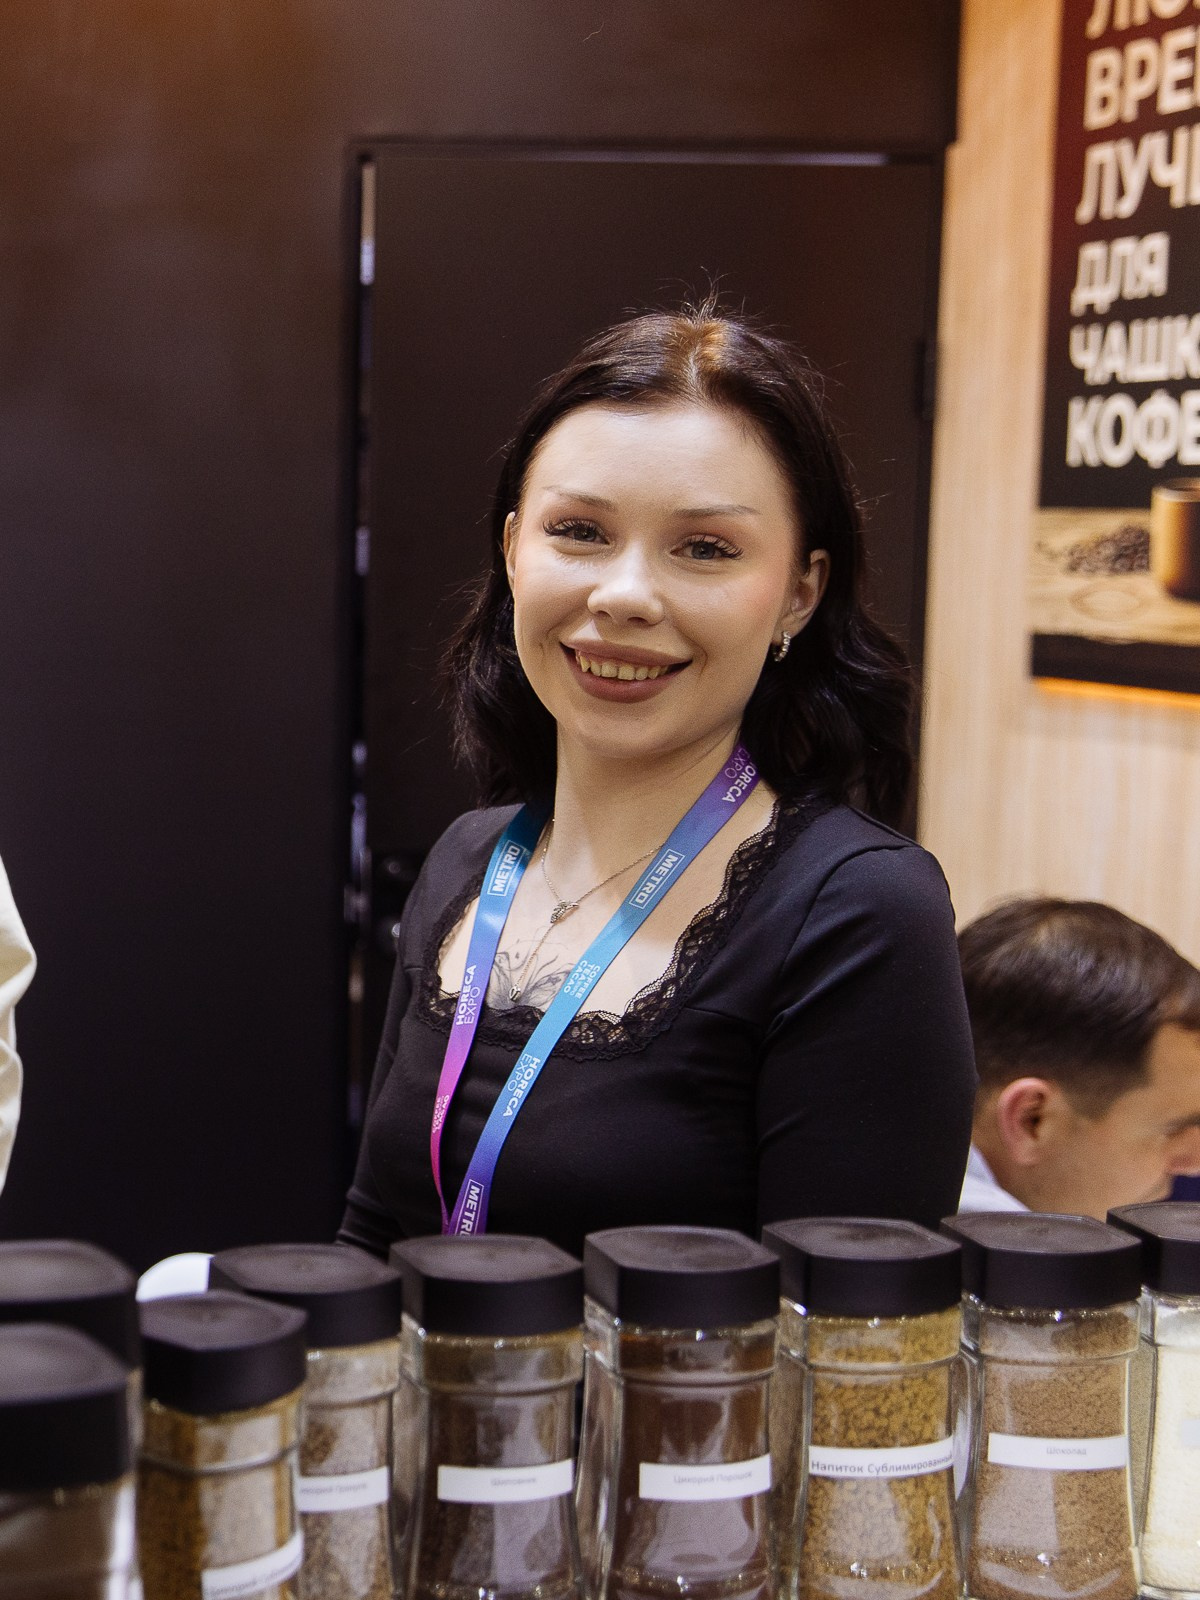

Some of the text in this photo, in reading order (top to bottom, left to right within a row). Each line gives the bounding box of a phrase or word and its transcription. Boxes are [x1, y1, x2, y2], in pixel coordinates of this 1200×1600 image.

[1083, 25, 1200, 130] ВРЕ
[1075, 122, 1200, 225] ЛУЧ
[1070, 231, 1170, 317] ДЛЯ
[1065, 388, 1200, 469] КОФЕ
[722, 762, 758, 803] ORECA
[724, 747, 751, 779] EXPO
[492, 845, 521, 894] METRO
[634, 854, 679, 905] METRO
[456, 965, 477, 1026] HORECA
[564, 960, 588, 994] CACAO
[574, 965, 601, 999] COFFEE
[578, 963, 595, 983] TEA
[464, 986, 481, 1025] EXPO
[503, 1057, 542, 1118] HORECA
[507, 1053, 532, 1092] EXPO
[811, 1461, 864, 1474] Напиток
